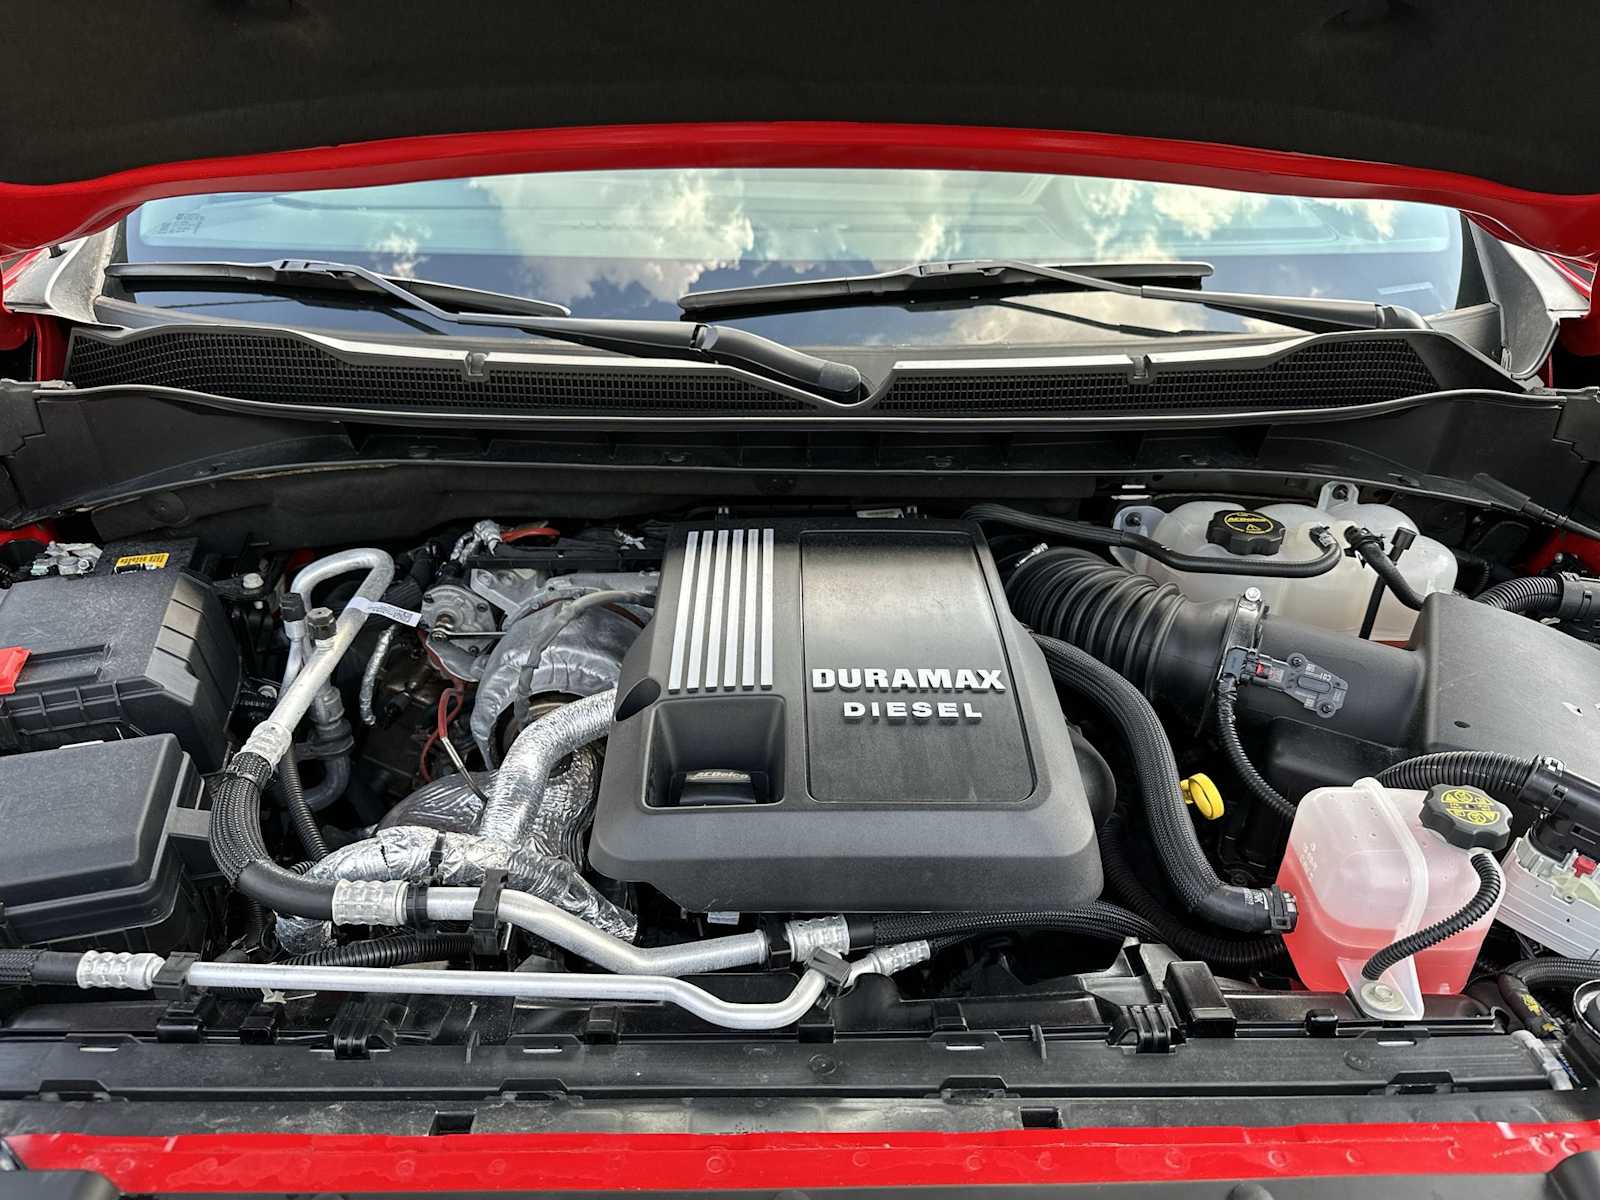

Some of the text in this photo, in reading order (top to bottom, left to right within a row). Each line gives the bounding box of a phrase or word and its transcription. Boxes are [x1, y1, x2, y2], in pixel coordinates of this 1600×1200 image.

[812, 668, 1006, 691] DURAMAX
[843, 702, 983, 718] DIESEL
[692, 771, 750, 780] ACDelco
